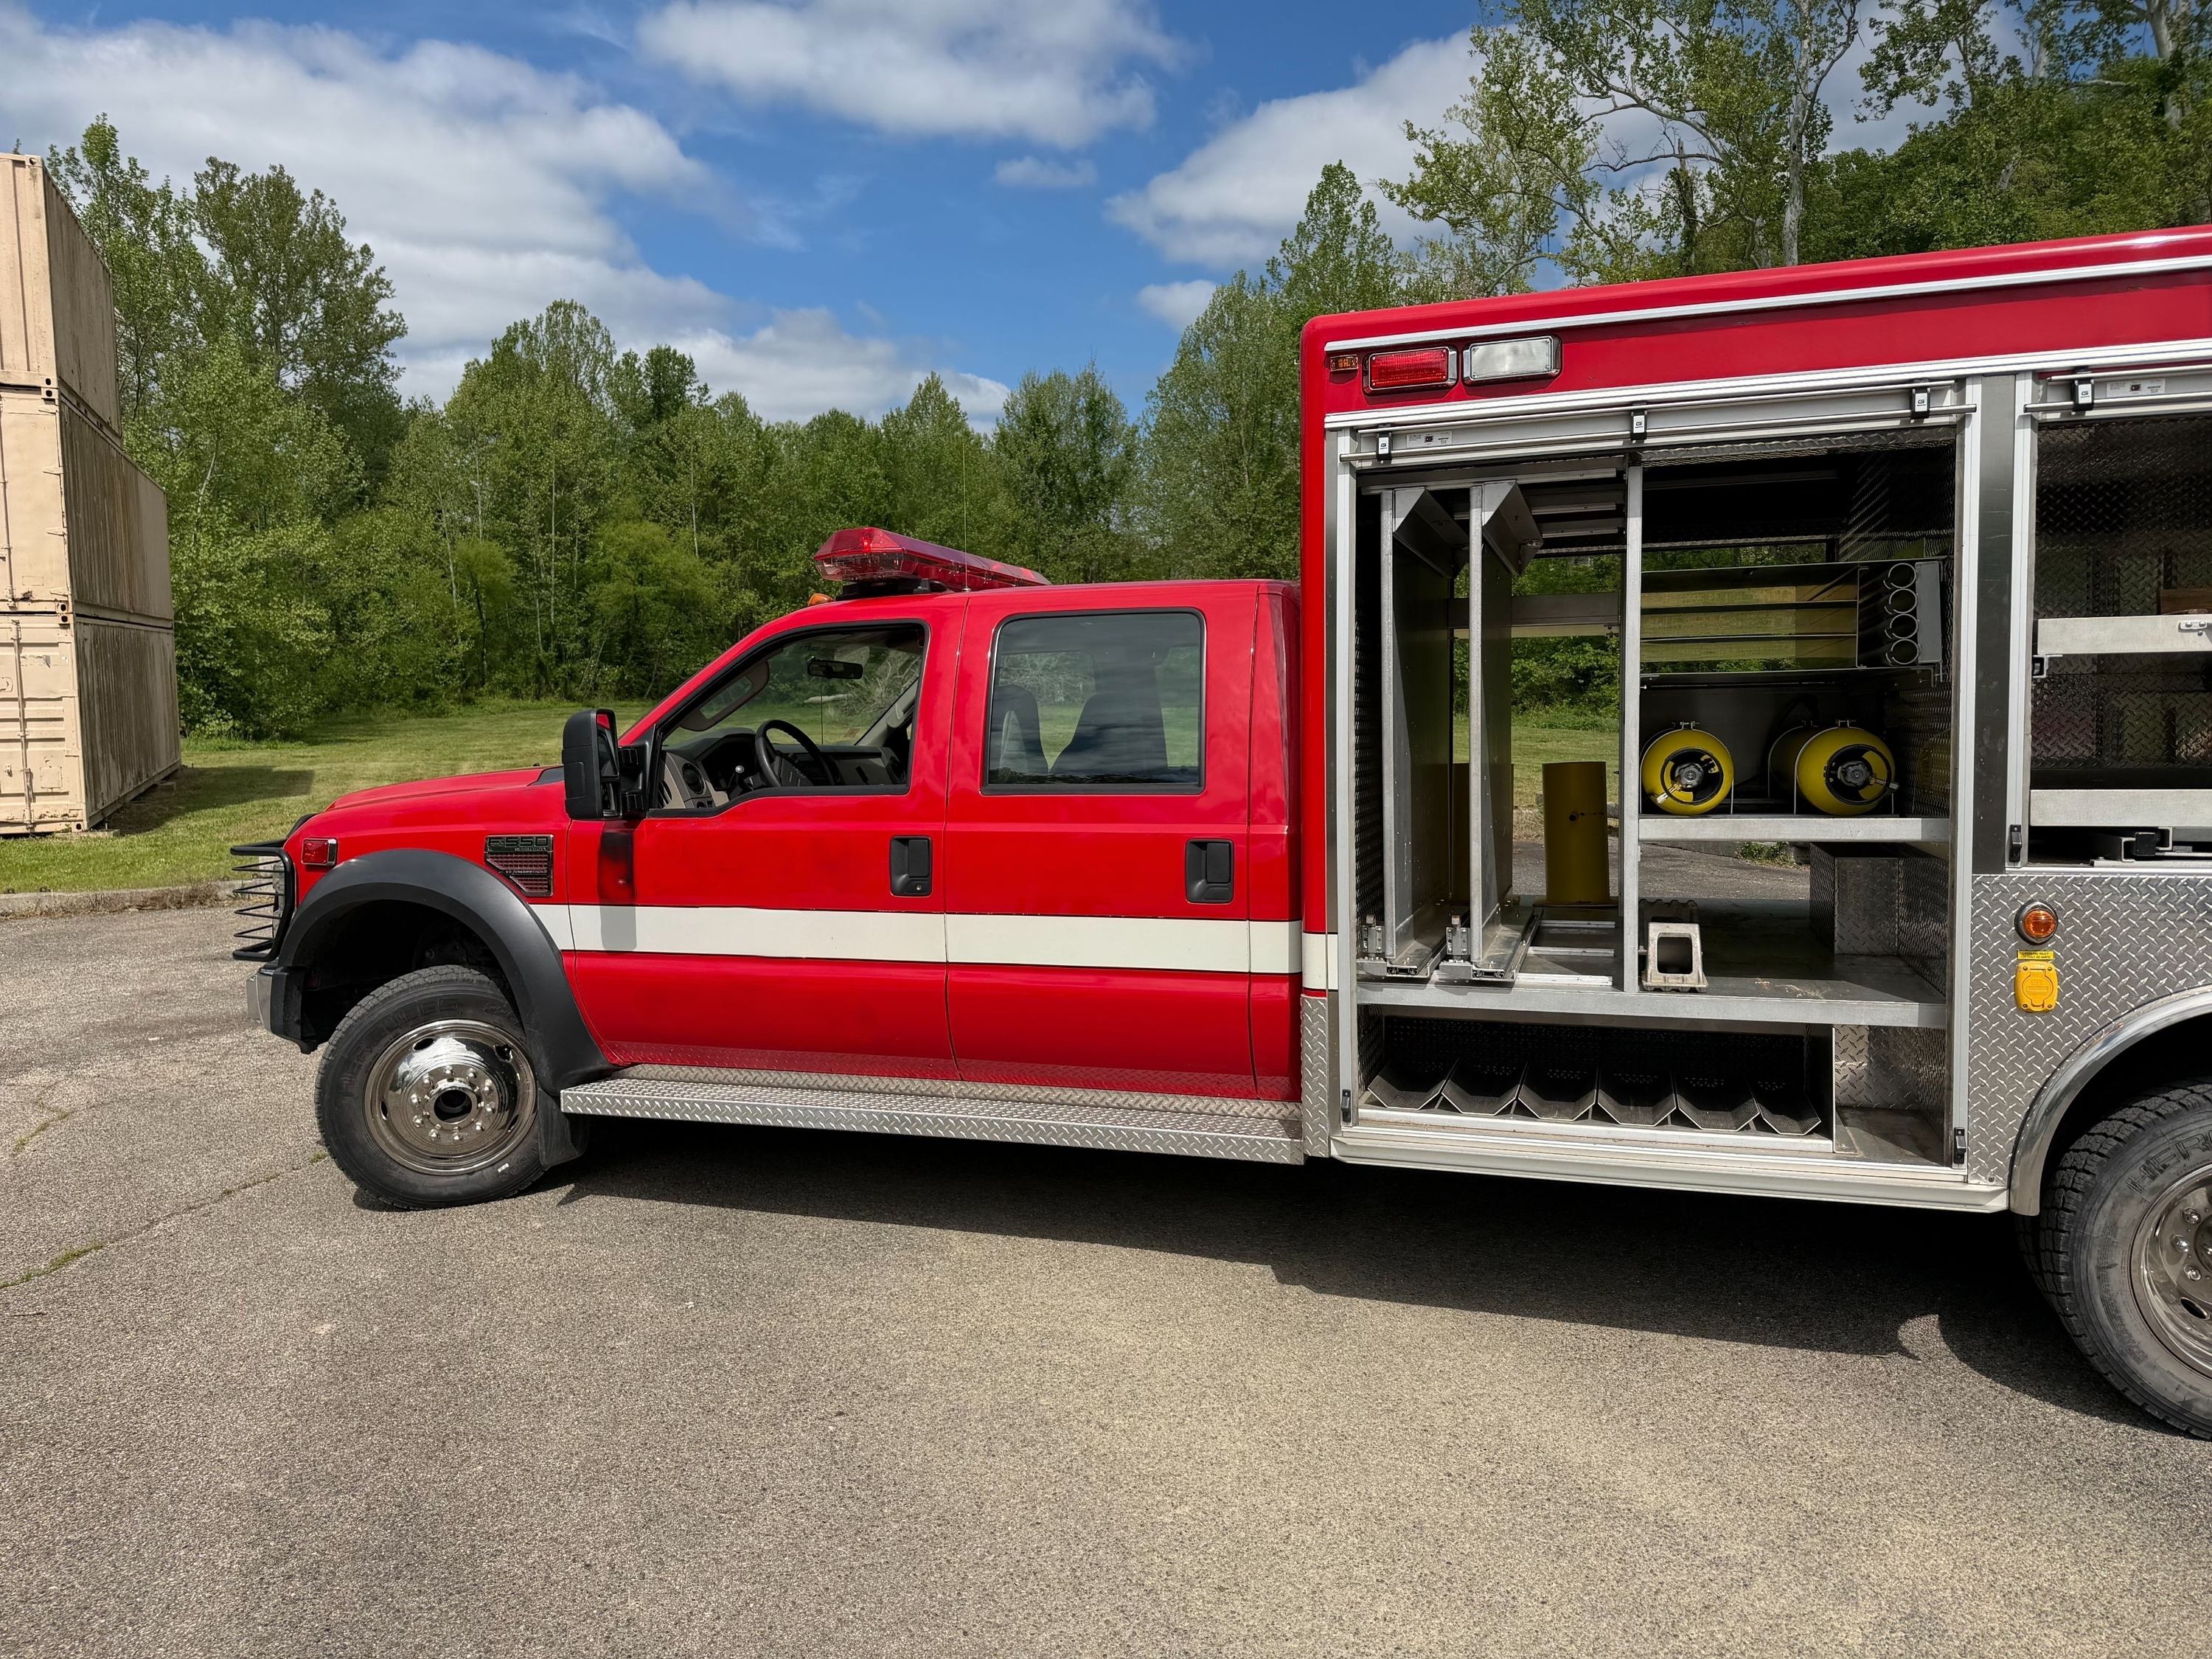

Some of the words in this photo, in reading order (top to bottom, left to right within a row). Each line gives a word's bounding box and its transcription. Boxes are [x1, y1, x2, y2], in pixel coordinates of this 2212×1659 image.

[487, 837, 548, 847] F-550
[338, 998, 459, 1097] HERCULES
[2126, 1130, 2212, 1194] HER
